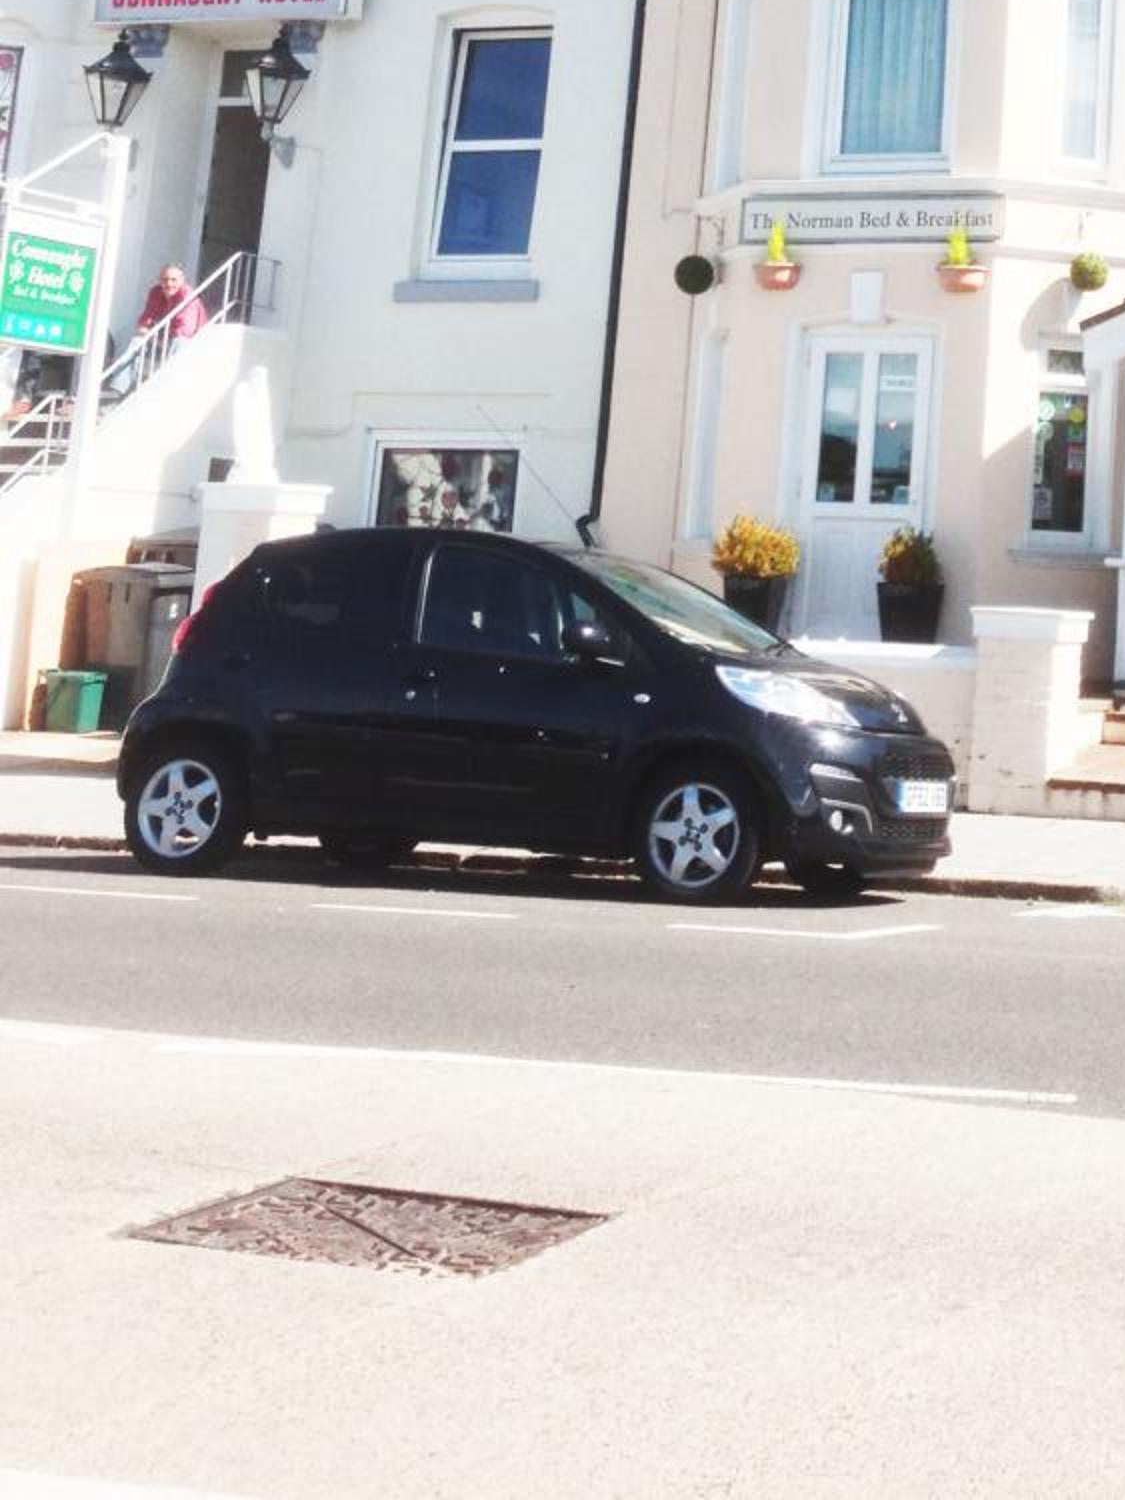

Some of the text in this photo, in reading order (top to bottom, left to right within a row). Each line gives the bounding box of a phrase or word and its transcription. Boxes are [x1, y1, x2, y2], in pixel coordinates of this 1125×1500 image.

[785, 211, 854, 229] Norman
[860, 211, 891, 229] Bed
[896, 210, 911, 228] &
